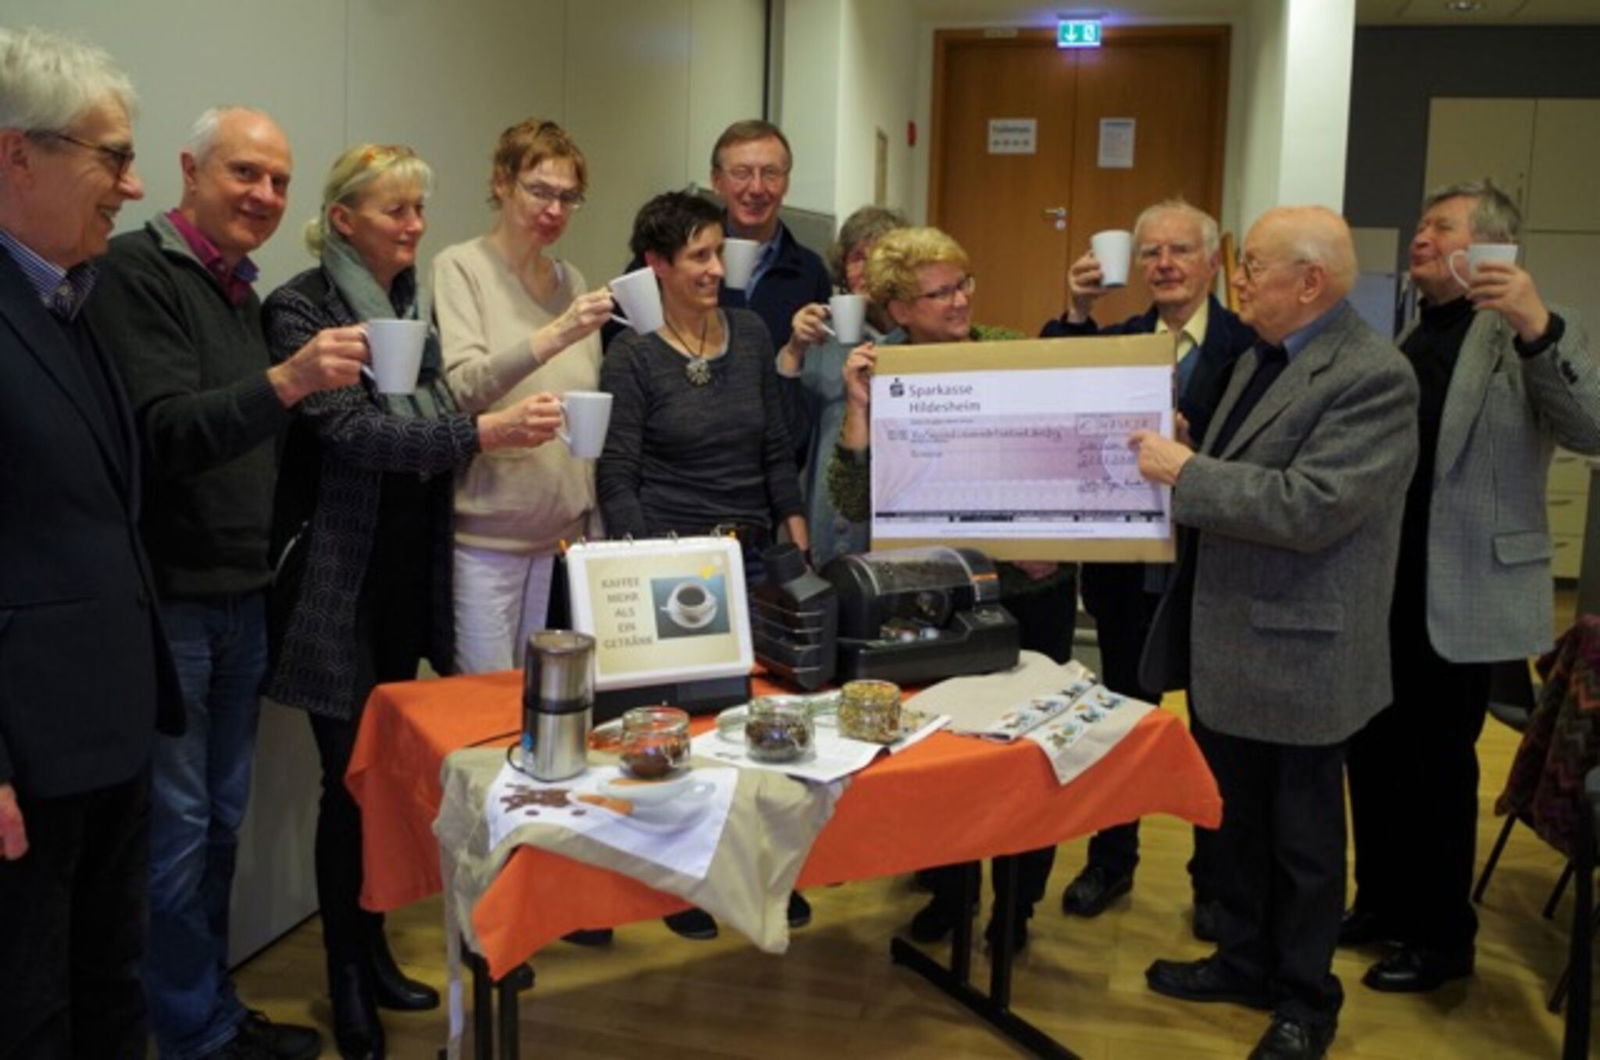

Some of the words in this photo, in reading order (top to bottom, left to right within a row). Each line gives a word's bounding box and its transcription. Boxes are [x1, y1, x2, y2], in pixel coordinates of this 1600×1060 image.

[909, 383, 973, 398] Sparkasse
[909, 401, 981, 413] Hildesheim
[601, 577, 639, 589] KAFFEE
[607, 592, 639, 602] MEHR
[614, 607, 635, 617] ALS
